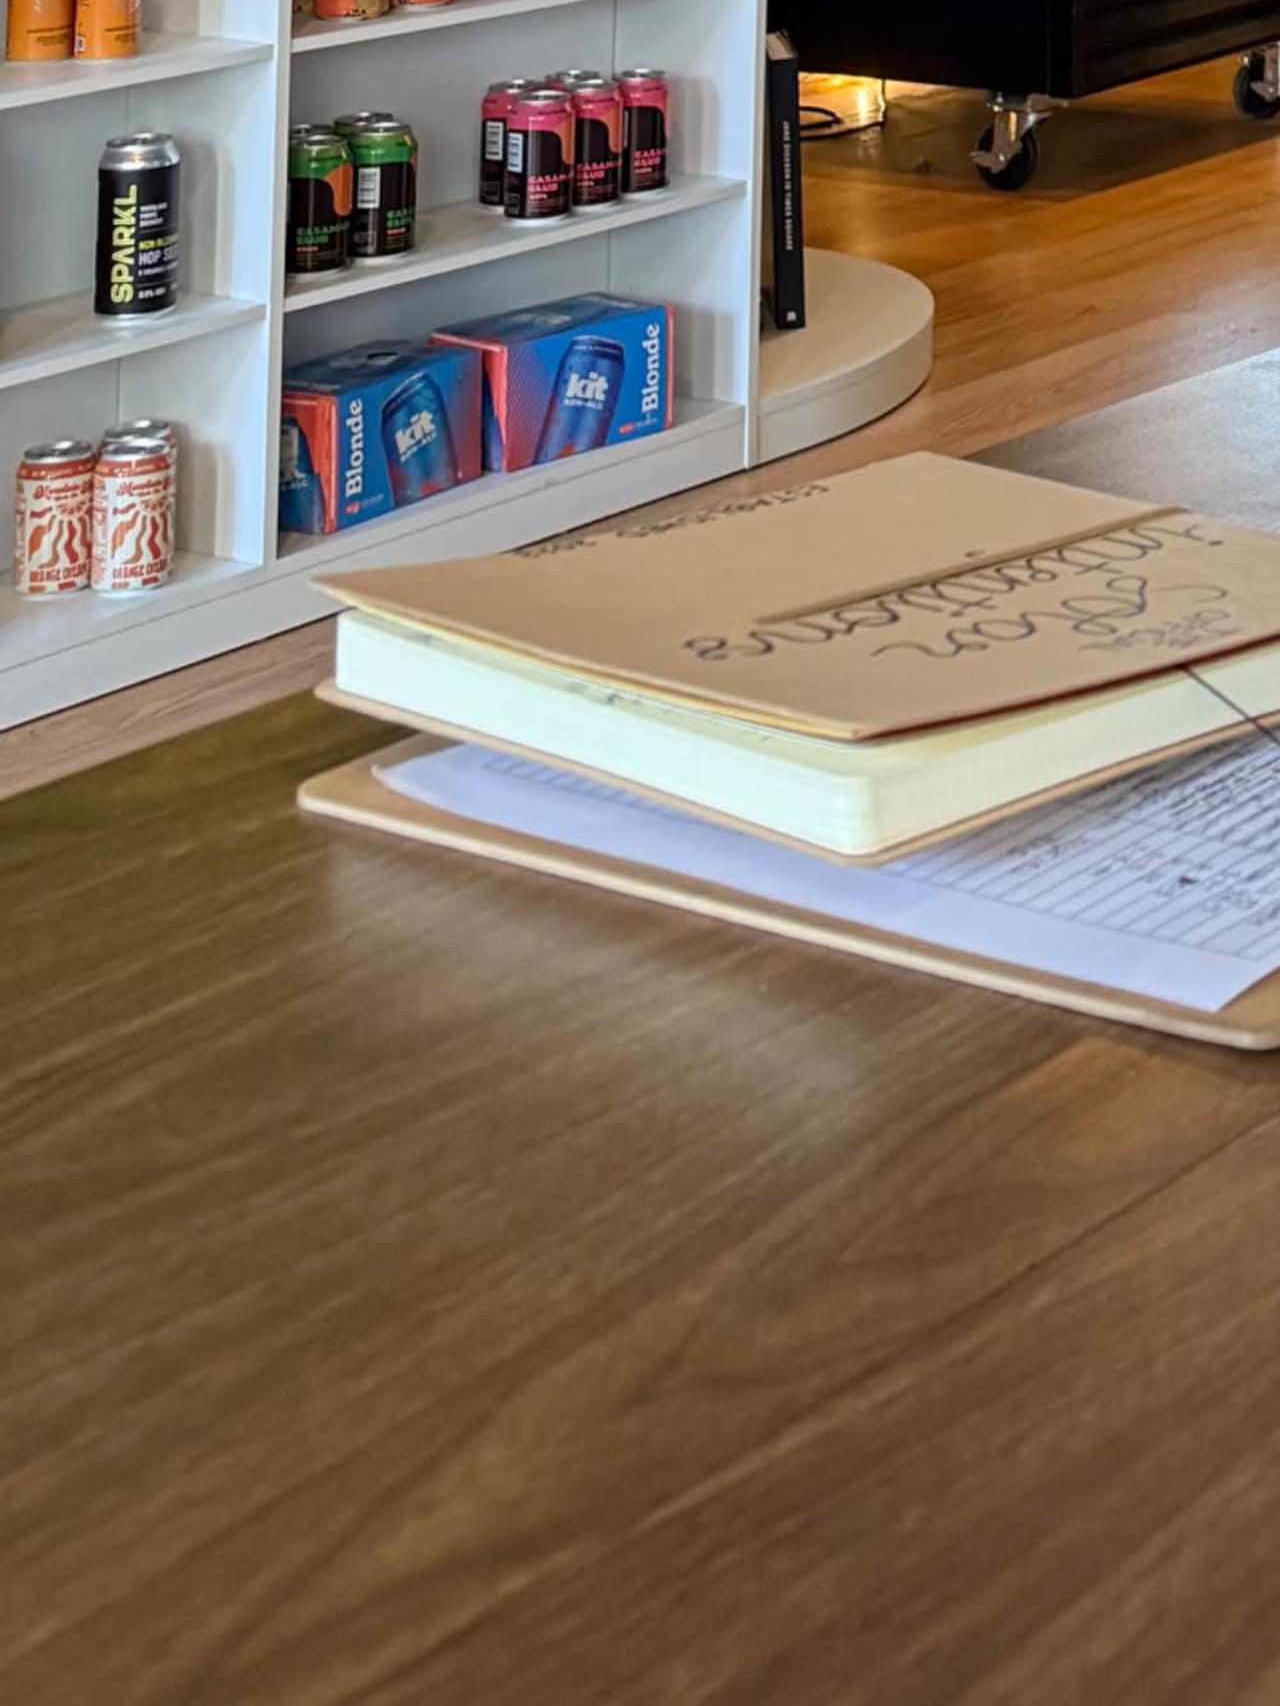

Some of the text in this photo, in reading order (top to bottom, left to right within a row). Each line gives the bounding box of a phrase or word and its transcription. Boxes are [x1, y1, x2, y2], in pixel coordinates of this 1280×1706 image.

[111, 184, 138, 304] SPARKL
[641, 323, 660, 415] Blonde
[345, 397, 364, 498] Blonde
